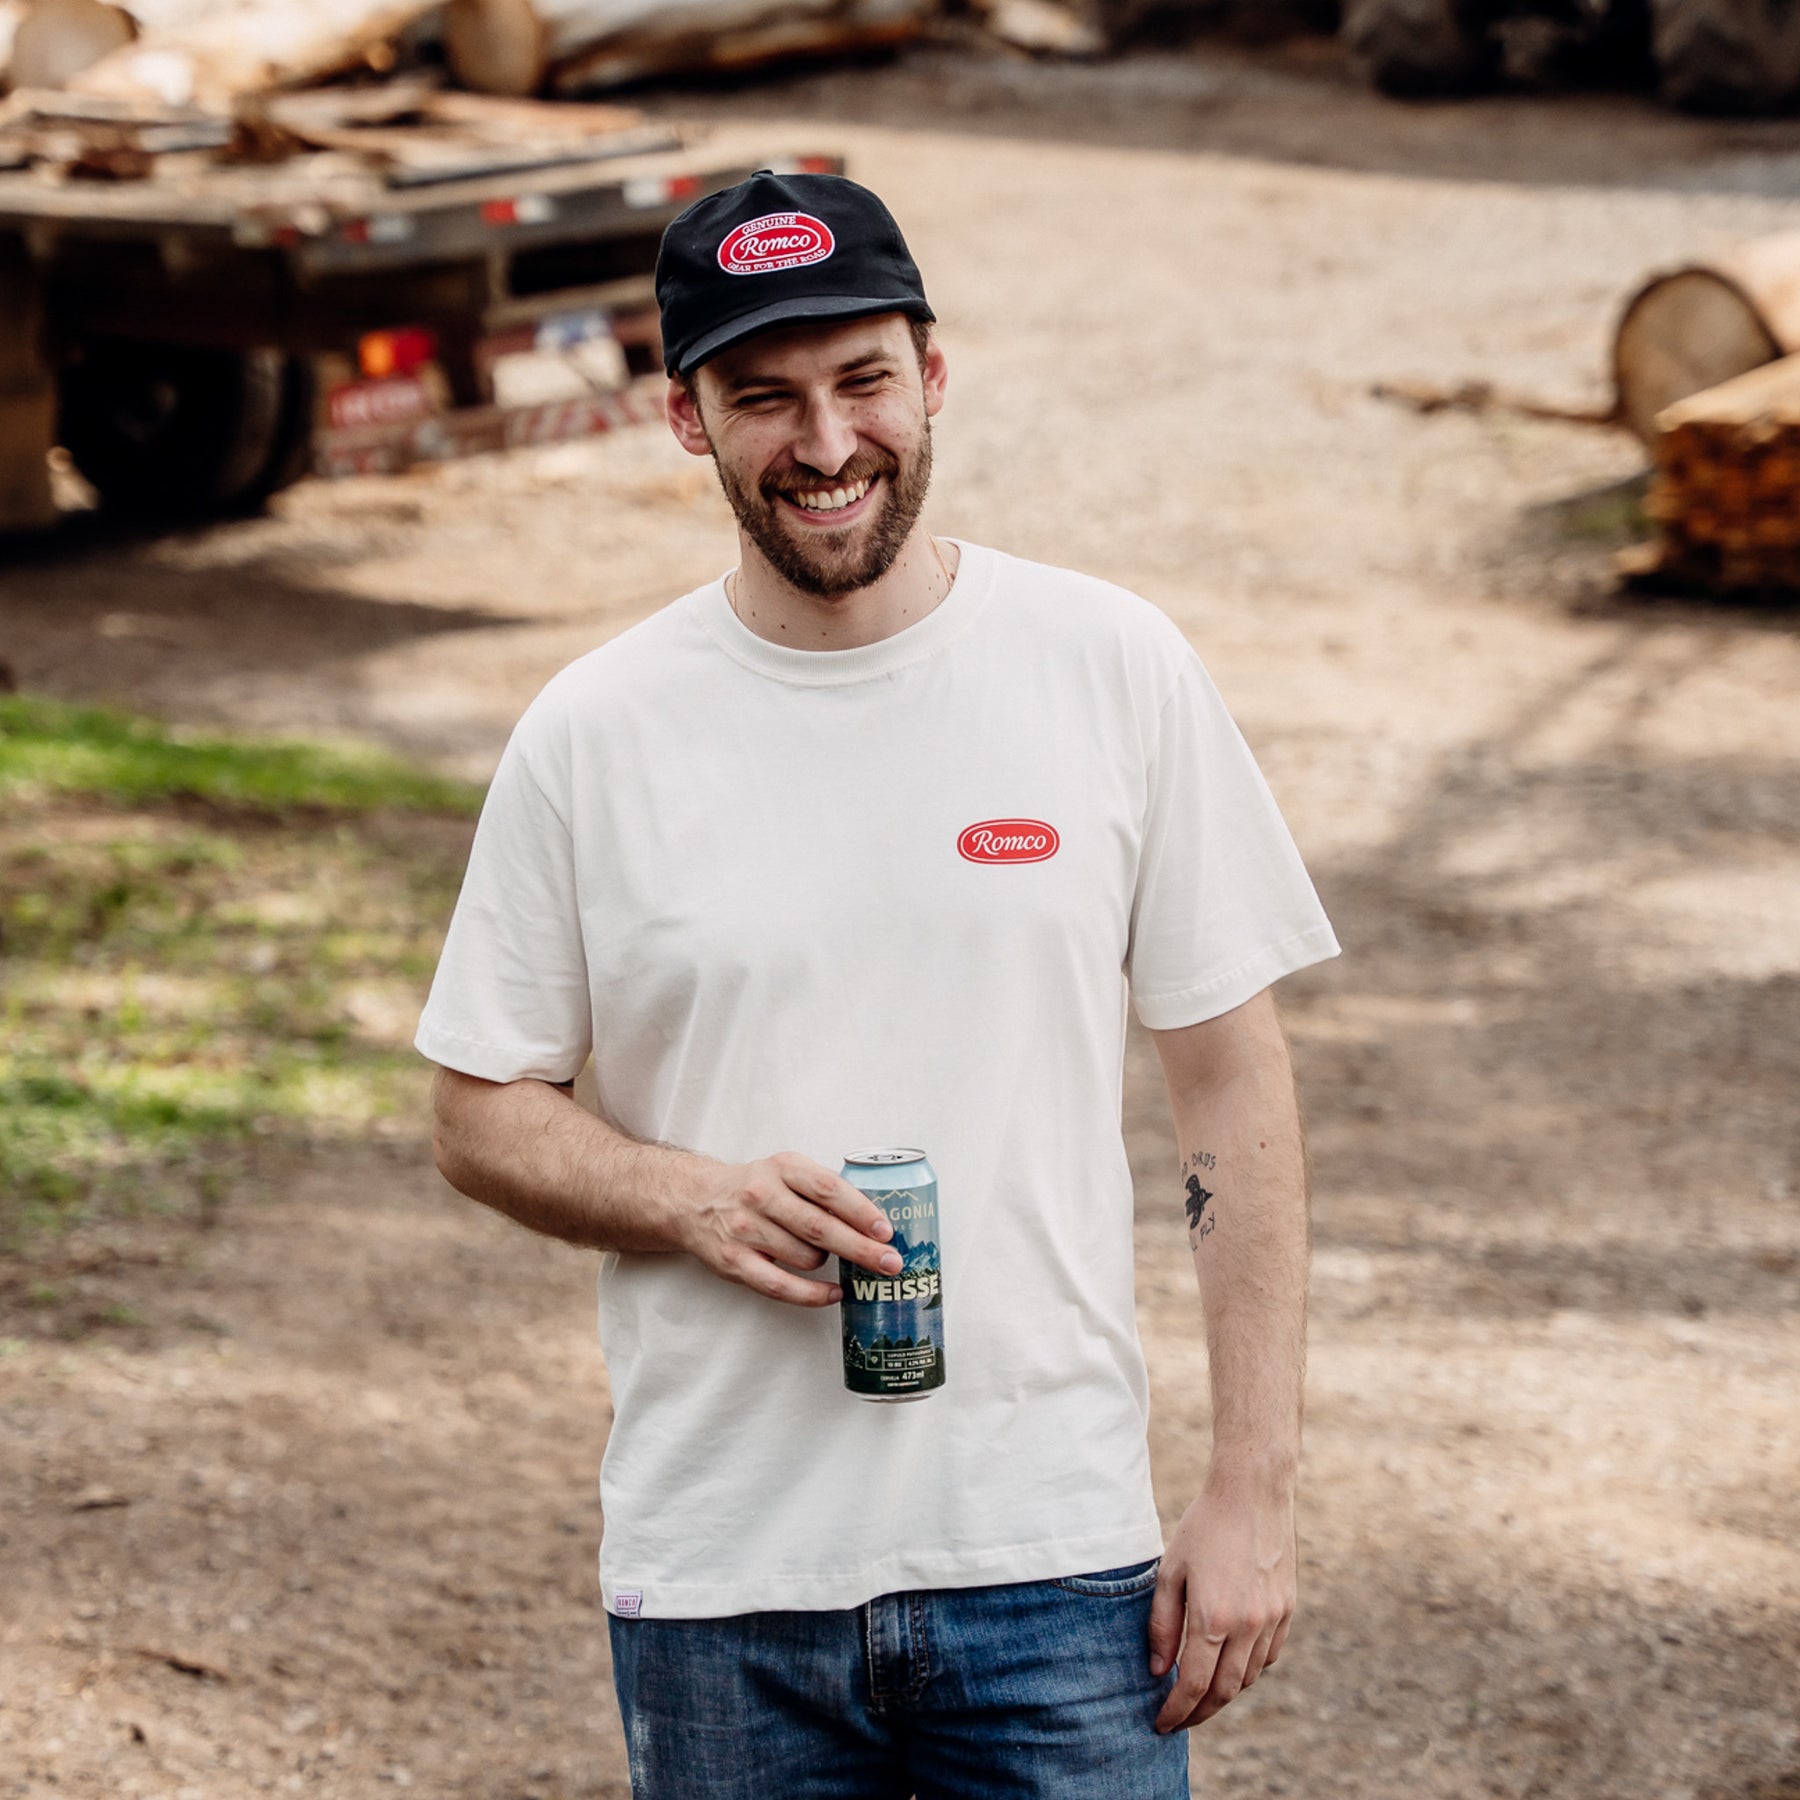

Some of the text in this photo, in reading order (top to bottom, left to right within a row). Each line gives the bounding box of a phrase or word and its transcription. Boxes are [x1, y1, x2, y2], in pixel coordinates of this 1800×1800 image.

[741, 215, 797, 235] GENUINE
[739, 234, 811, 259] Romco
[727, 248, 827, 272] GEAR FOR THE ROAD
[971, 829, 1047, 856] Romco
[880, 1201, 935, 1221] AGONIA
[851, 1273, 939, 1301] WEISSE
[902, 1370, 925, 1380] 473ml
